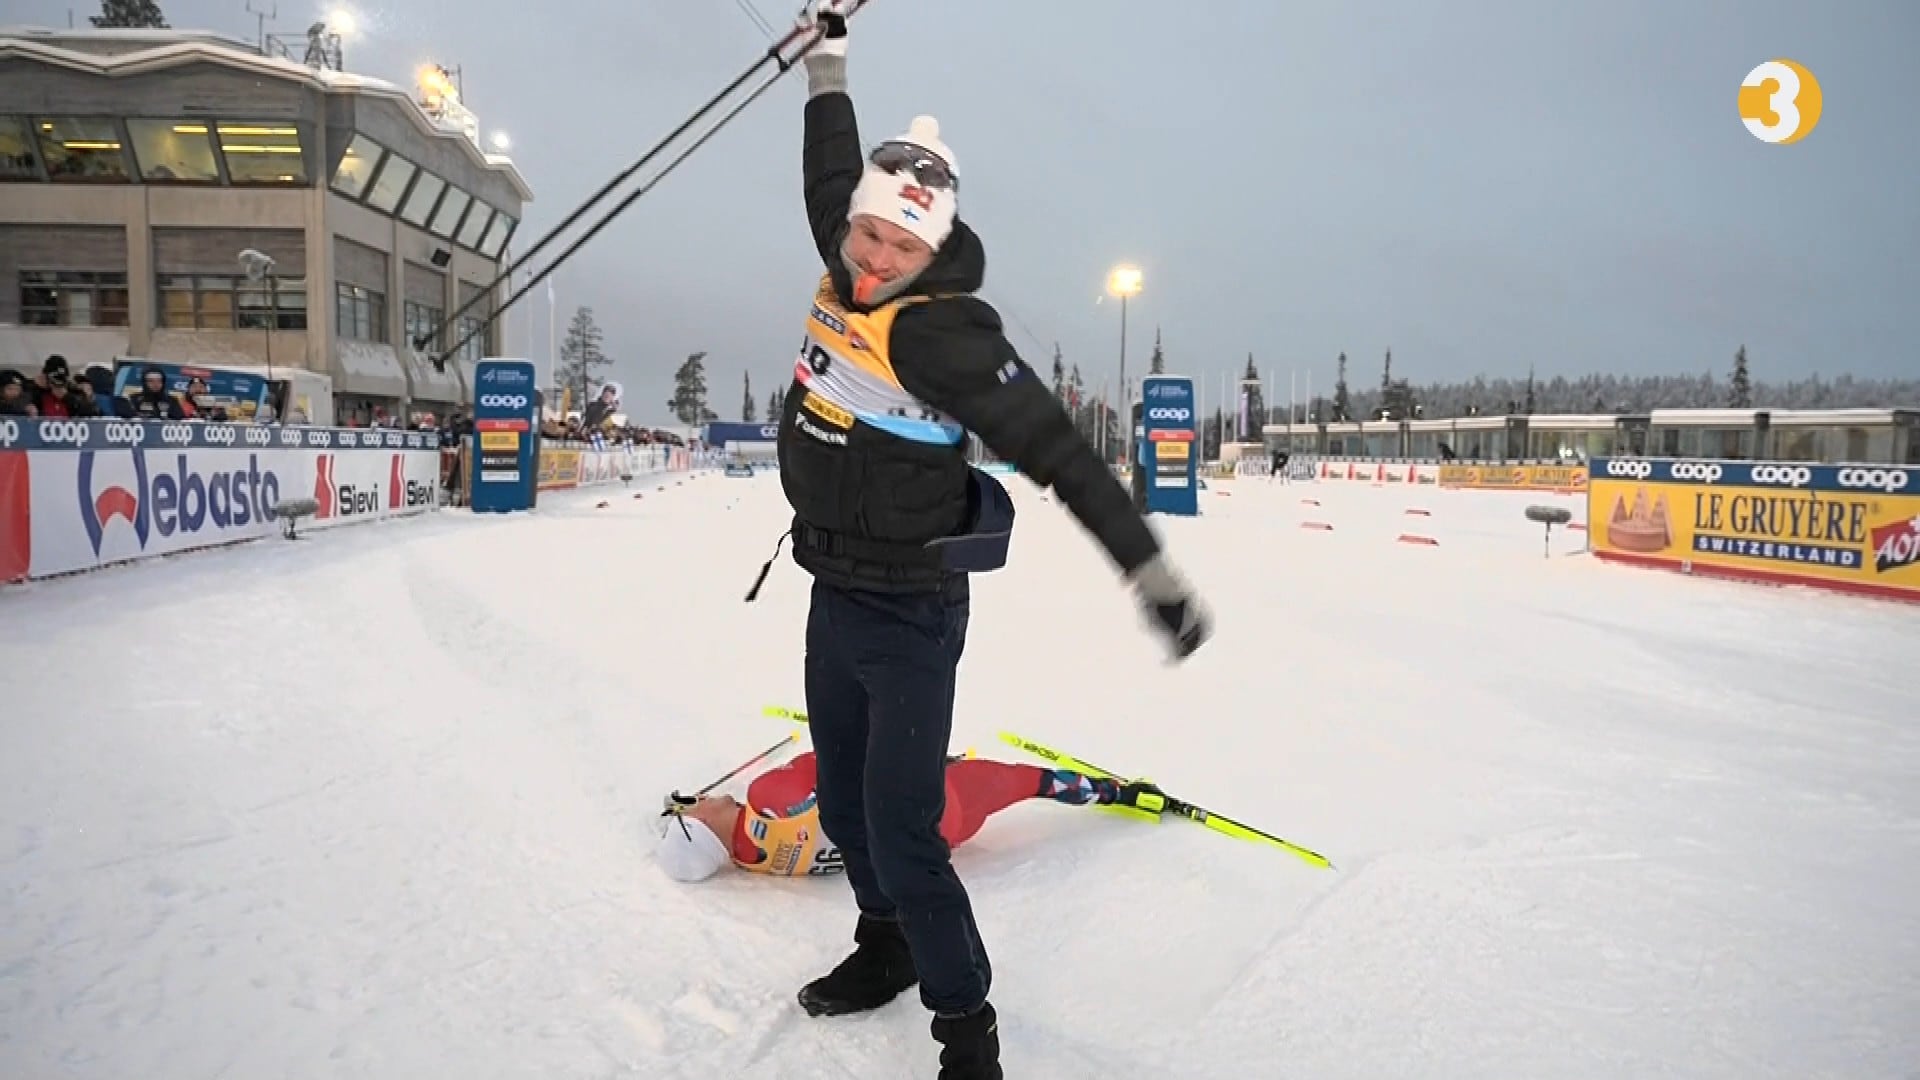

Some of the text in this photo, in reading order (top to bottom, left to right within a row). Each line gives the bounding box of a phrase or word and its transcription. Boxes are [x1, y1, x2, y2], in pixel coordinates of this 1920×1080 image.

[480, 394, 527, 409] coop
[1149, 408, 1190, 422] coop
[39, 421, 89, 447] coop
[105, 423, 145, 447] coop
[161, 424, 193, 446] coop
[204, 425, 236, 447] coop
[245, 427, 271, 447] coop
[1607, 461, 1908, 493] coop coop coop coop
[77, 449, 280, 558] Webasto
[339, 483, 378, 515] Sievi
[407, 479, 434, 506] Sievi
[1694, 489, 1867, 543] LE GRUYÈRE
[1697, 535, 1856, 565] SWITZERLAND
